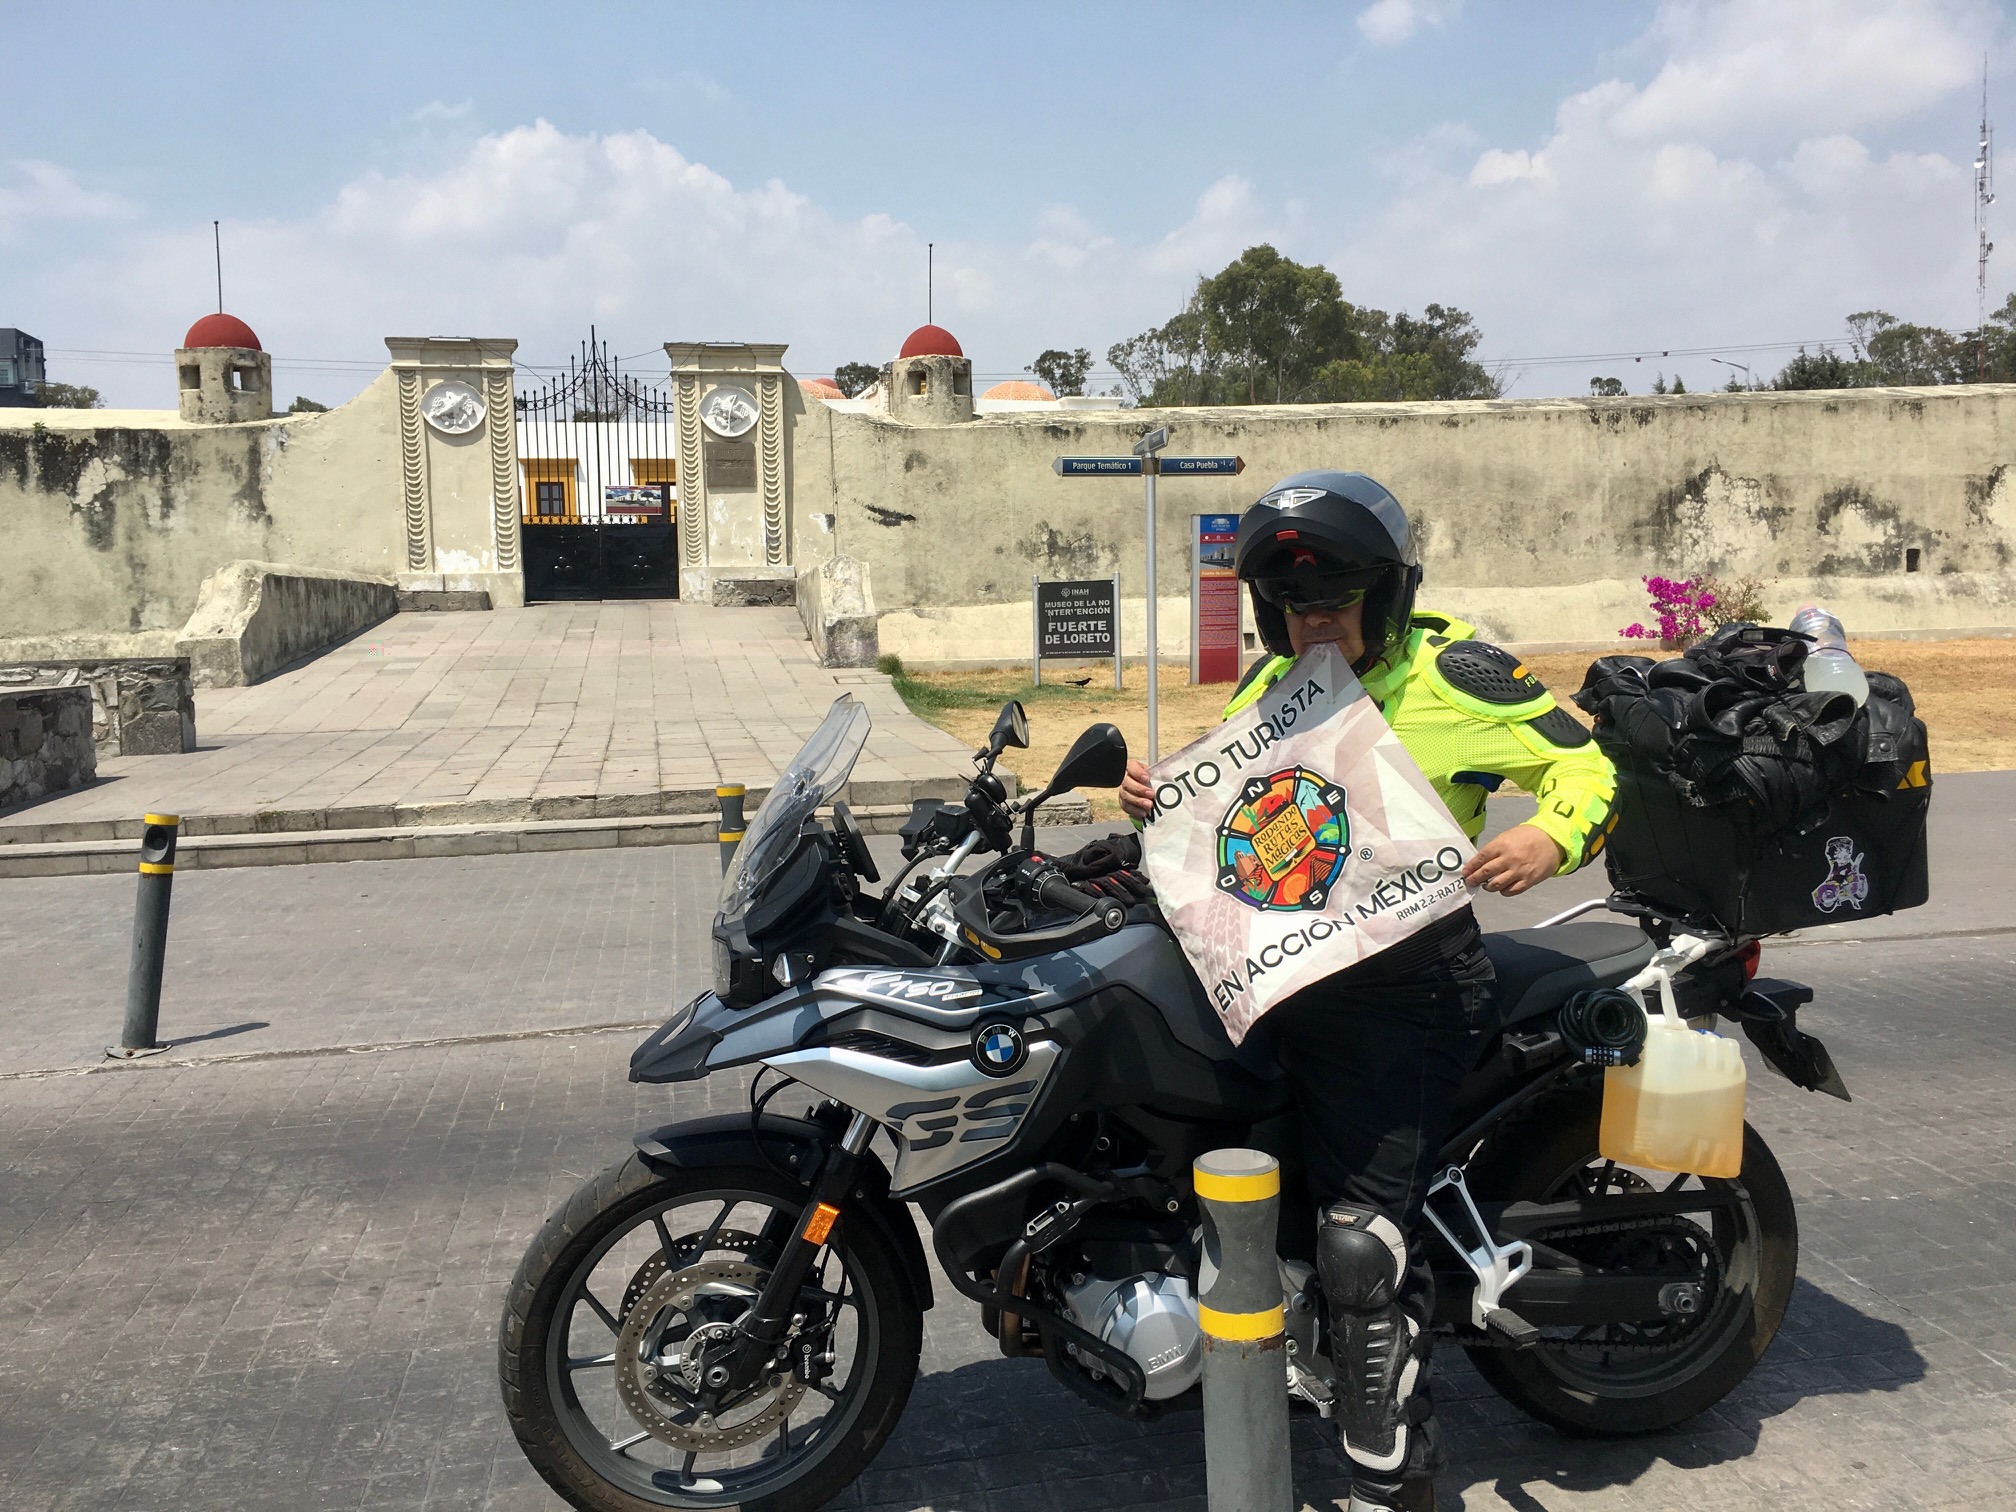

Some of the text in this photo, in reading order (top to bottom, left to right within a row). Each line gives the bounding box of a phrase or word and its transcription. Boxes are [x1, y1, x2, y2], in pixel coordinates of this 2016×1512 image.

[1072, 461, 1132, 471] Parque Temático 1
[1180, 461, 1218, 469] Casa Puebla
[1071, 588, 1090, 596] INAH
[1048, 620, 1107, 633] FUERTE
[1045, 632, 1111, 645] DE LORETO
[1221, 679, 1325, 770] TURISTA
[1395, 903, 1422, 921] RRM
[1213, 846, 1463, 1012] EN ACCIÓN MÉXICO
[887, 980, 955, 998] 750
[979, 1026, 1018, 1045] BMW
[803, 1353, 811, 1380] brembo
[1147, 1344, 1184, 1371] BMW
